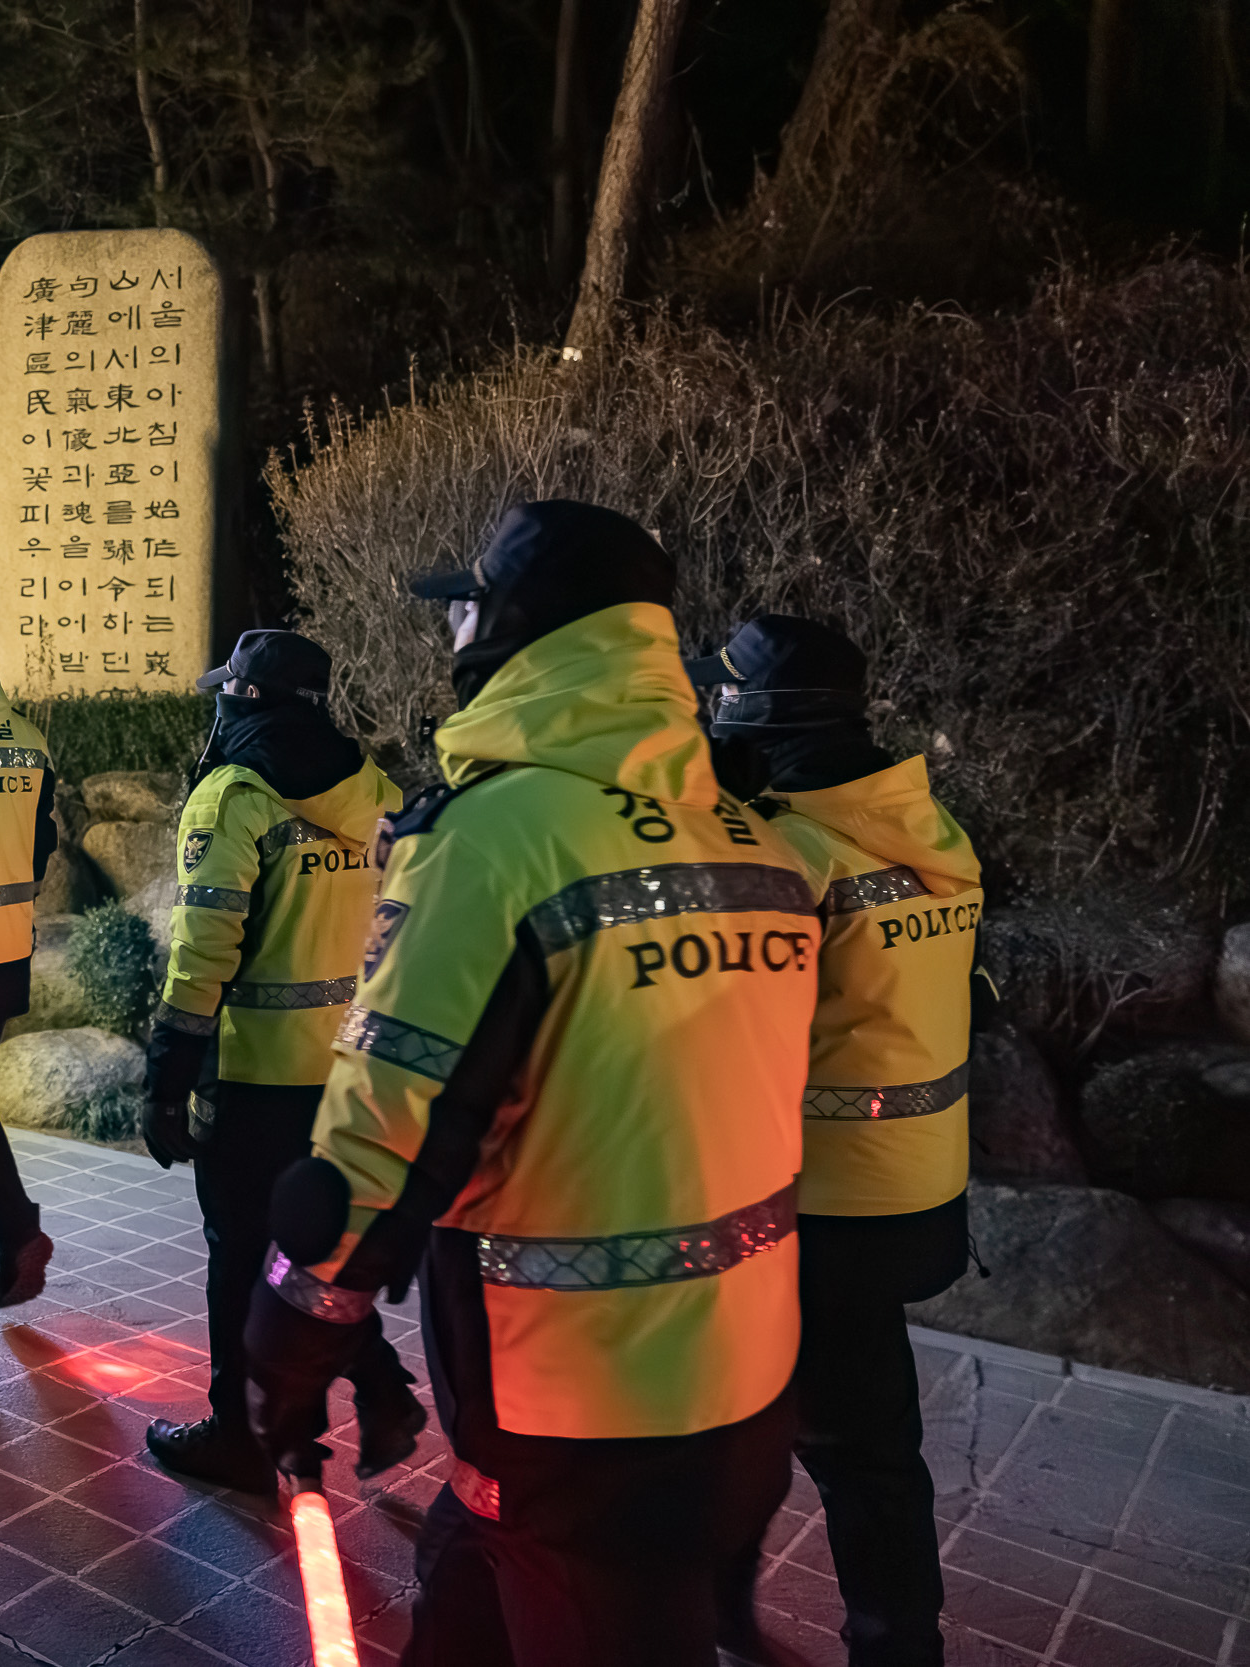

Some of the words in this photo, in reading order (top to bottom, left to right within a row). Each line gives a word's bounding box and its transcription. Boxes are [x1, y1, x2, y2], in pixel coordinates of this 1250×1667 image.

[298, 848, 370, 875] POLI
[877, 902, 980, 950] POLICE
[625, 930, 814, 990] POLICE
